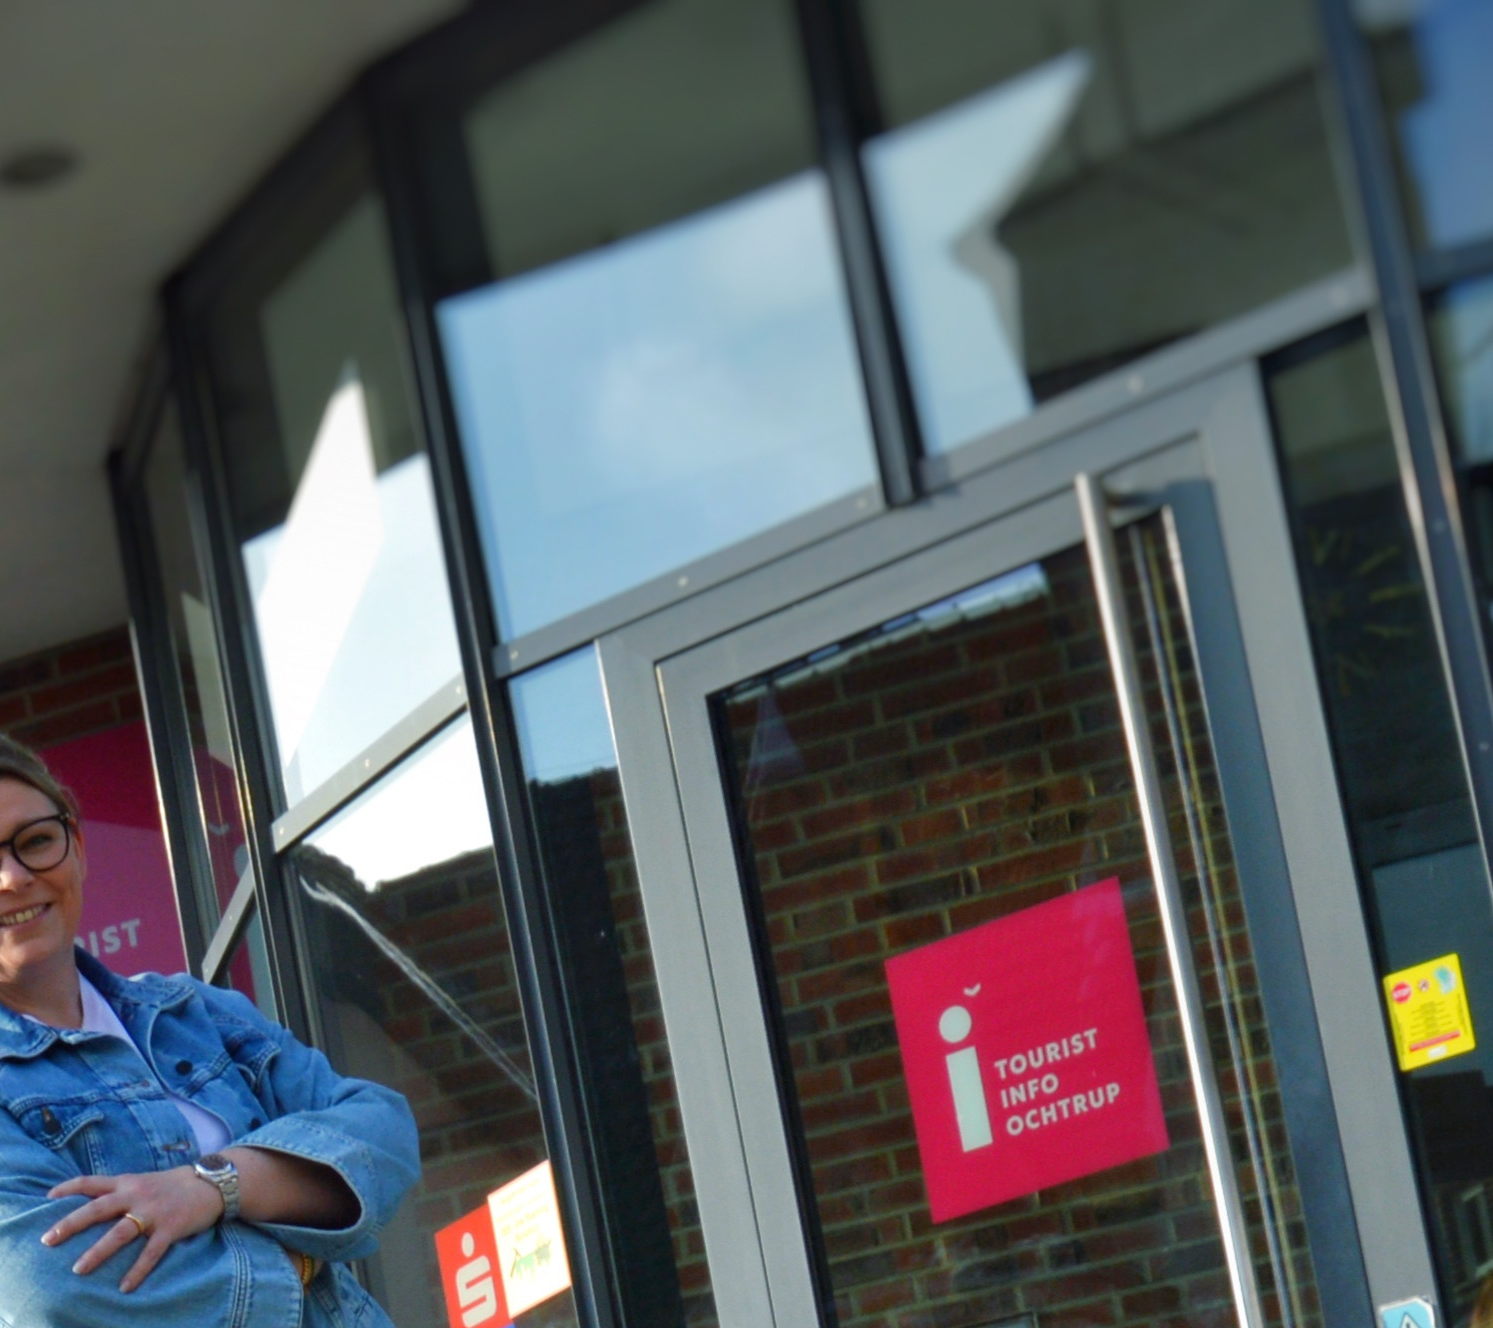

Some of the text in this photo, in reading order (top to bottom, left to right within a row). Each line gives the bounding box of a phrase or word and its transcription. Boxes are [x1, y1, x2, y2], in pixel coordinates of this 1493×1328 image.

[994, 1028, 1098, 1080] TOURIST
[1000, 1073, 1059, 1109] INFO
[1006, 1082, 1120, 1136] OCHTRUP
